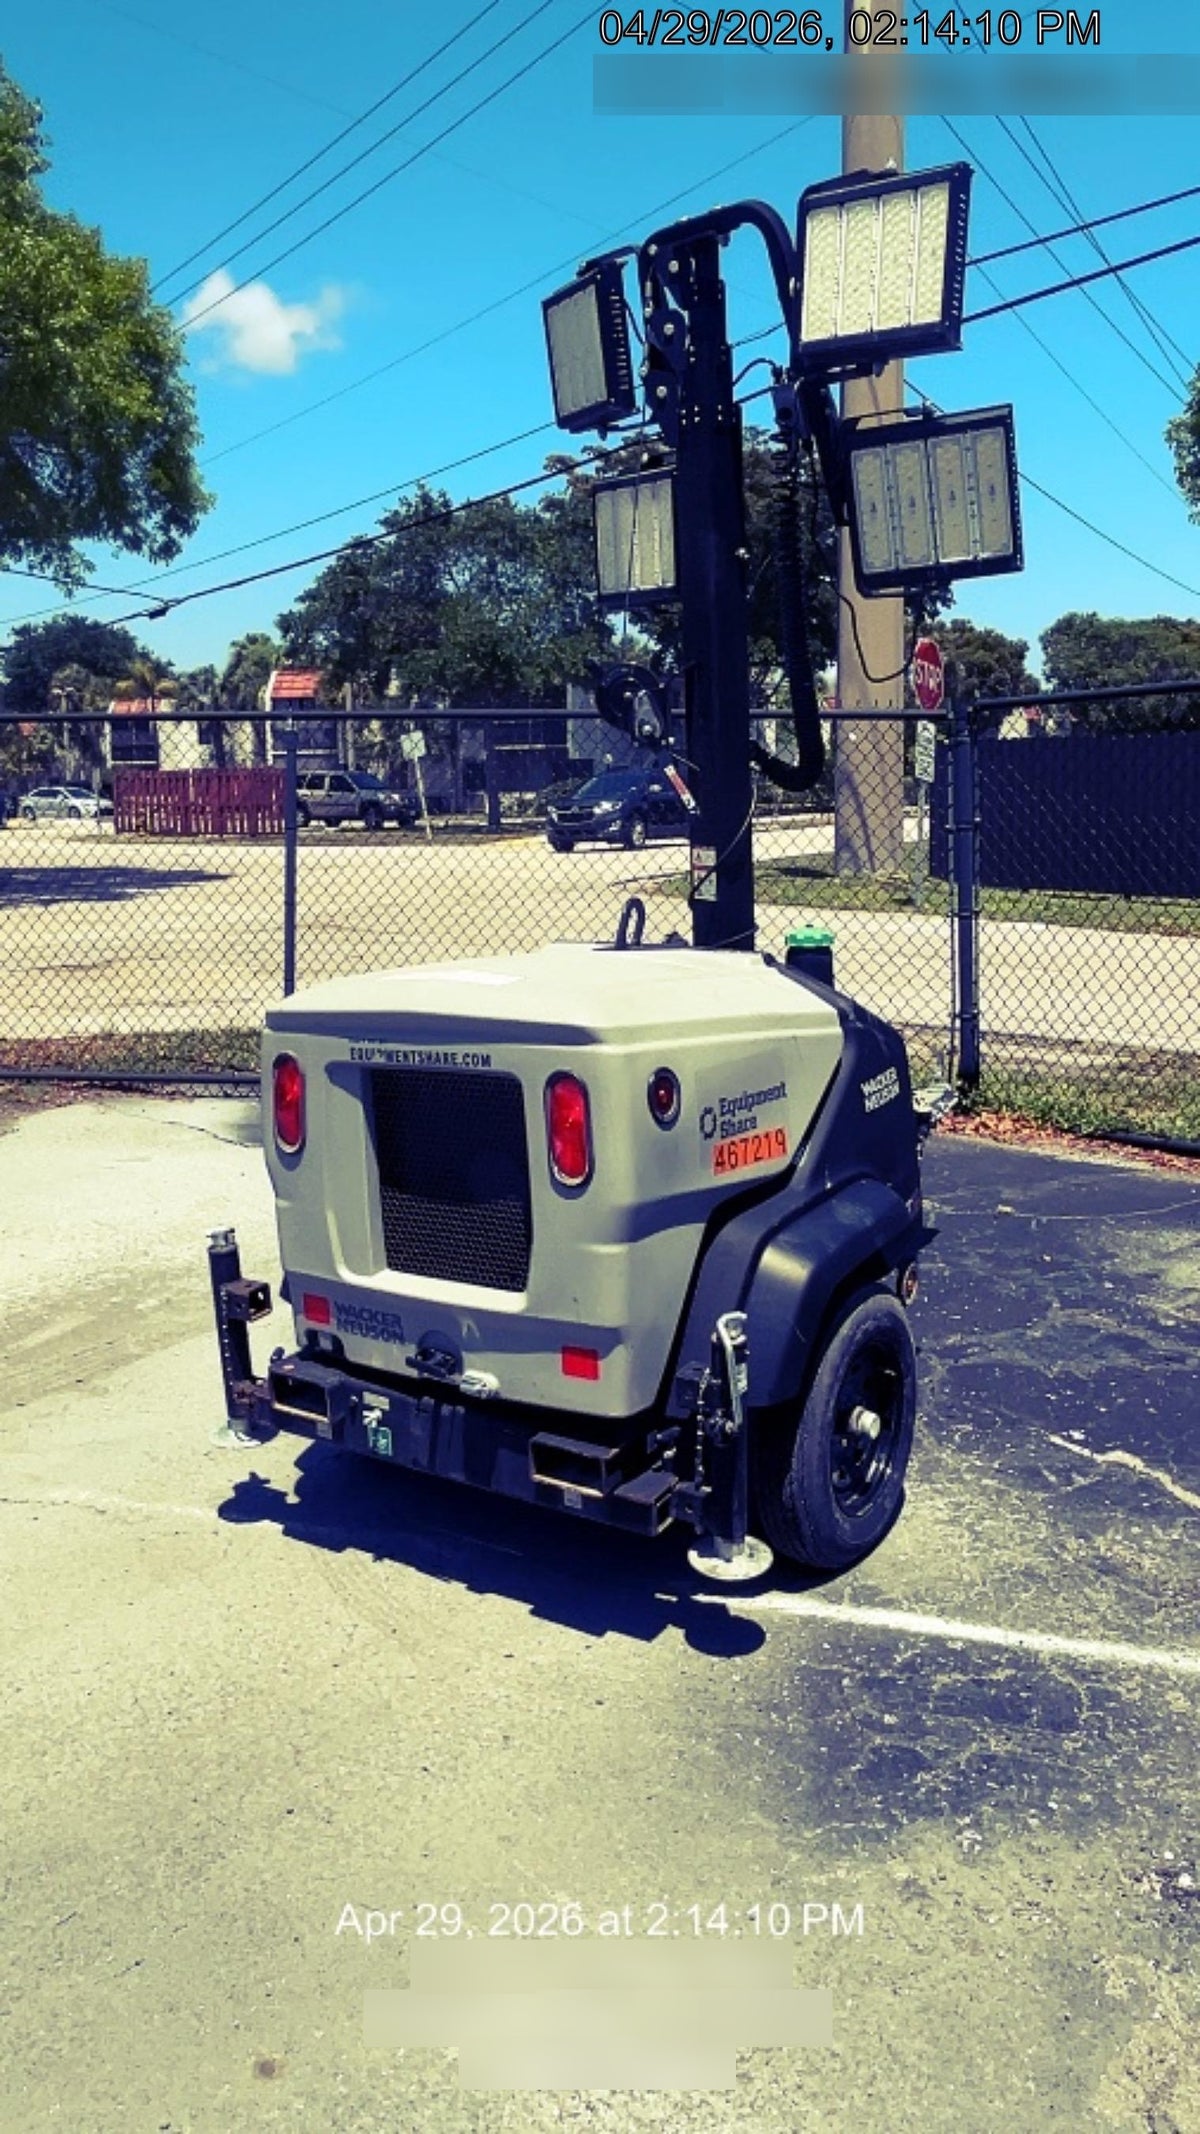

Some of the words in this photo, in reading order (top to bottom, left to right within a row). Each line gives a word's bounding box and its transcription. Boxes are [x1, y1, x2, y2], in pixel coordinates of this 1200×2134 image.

[719, 1081, 787, 1117] Equipment
[720, 1116, 757, 1139] Share
[714, 1128, 786, 1169] 467219
